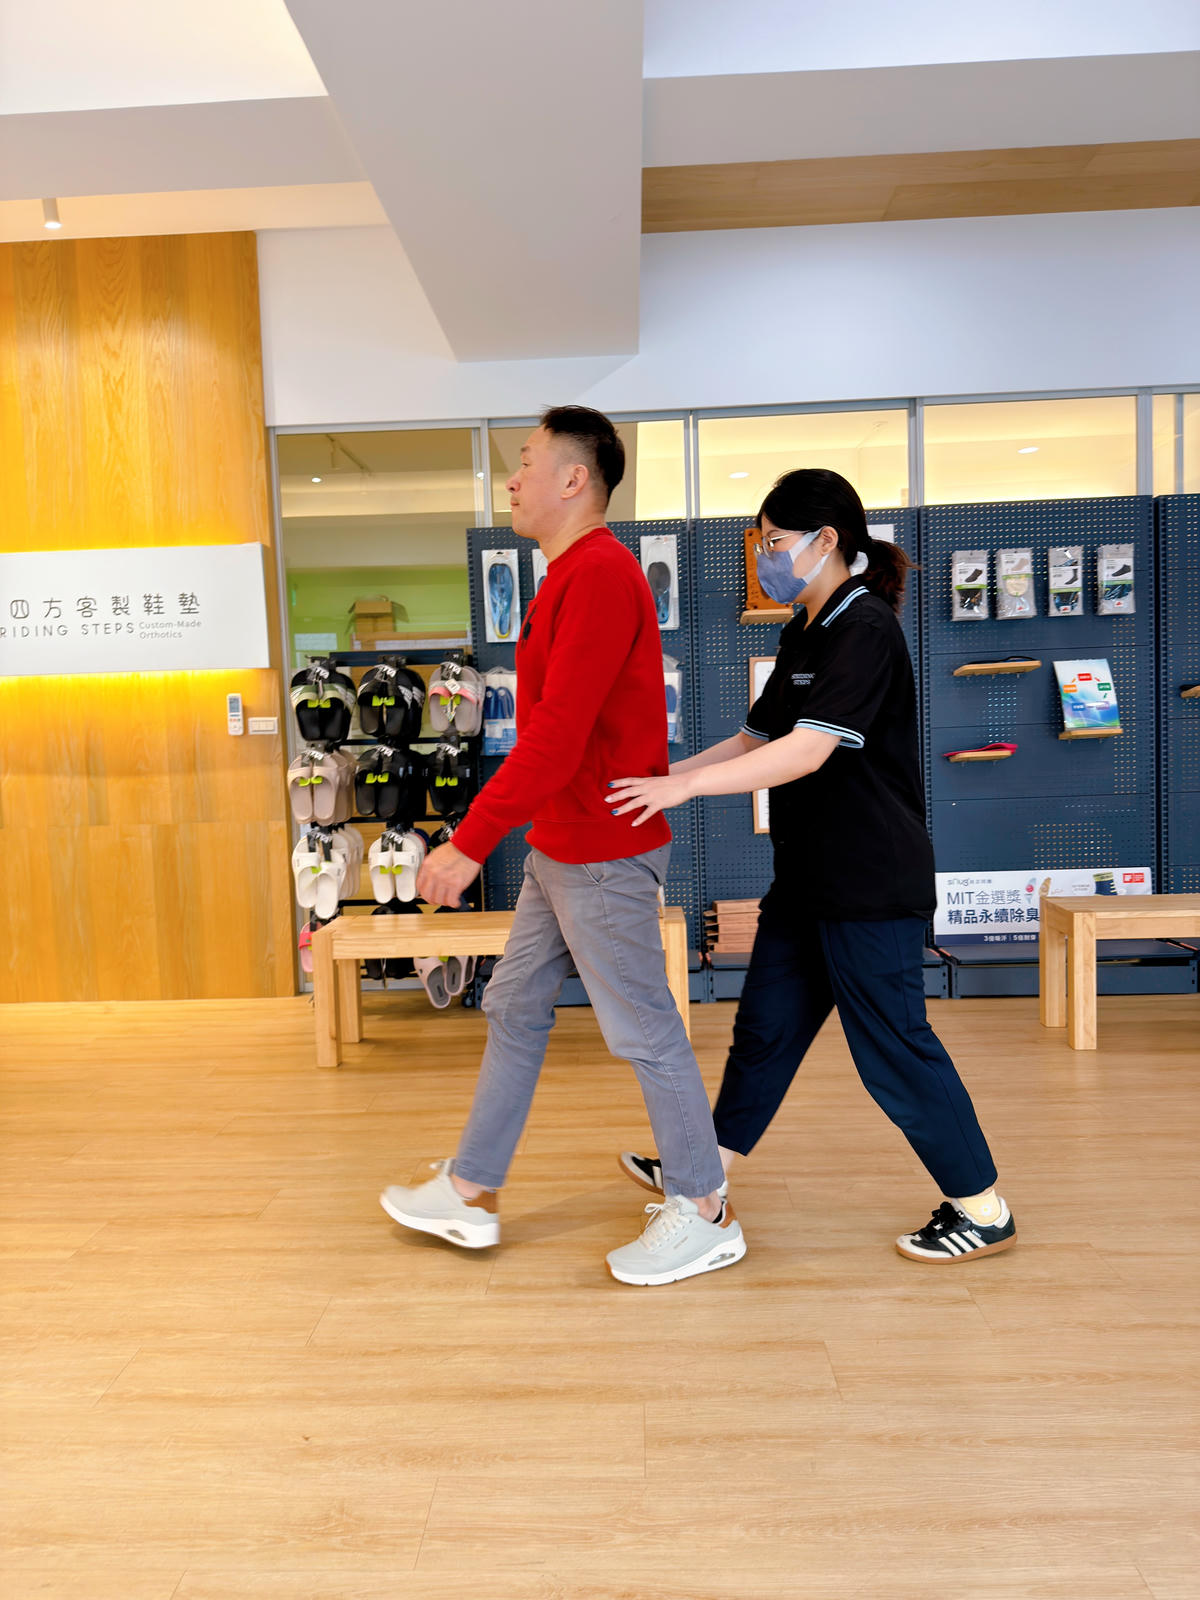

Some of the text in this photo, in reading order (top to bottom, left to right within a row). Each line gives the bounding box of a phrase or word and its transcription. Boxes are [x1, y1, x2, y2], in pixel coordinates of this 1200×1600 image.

[10, 592, 200, 619] 四方客製鞋墊
[81, 622, 134, 635] STEPS
[139, 620, 202, 630] Custom-Made
[139, 631, 183, 639] Orthotics
[947, 889, 1021, 905] MIT金選獎
[947, 908, 1040, 925] 精品永續除臭
